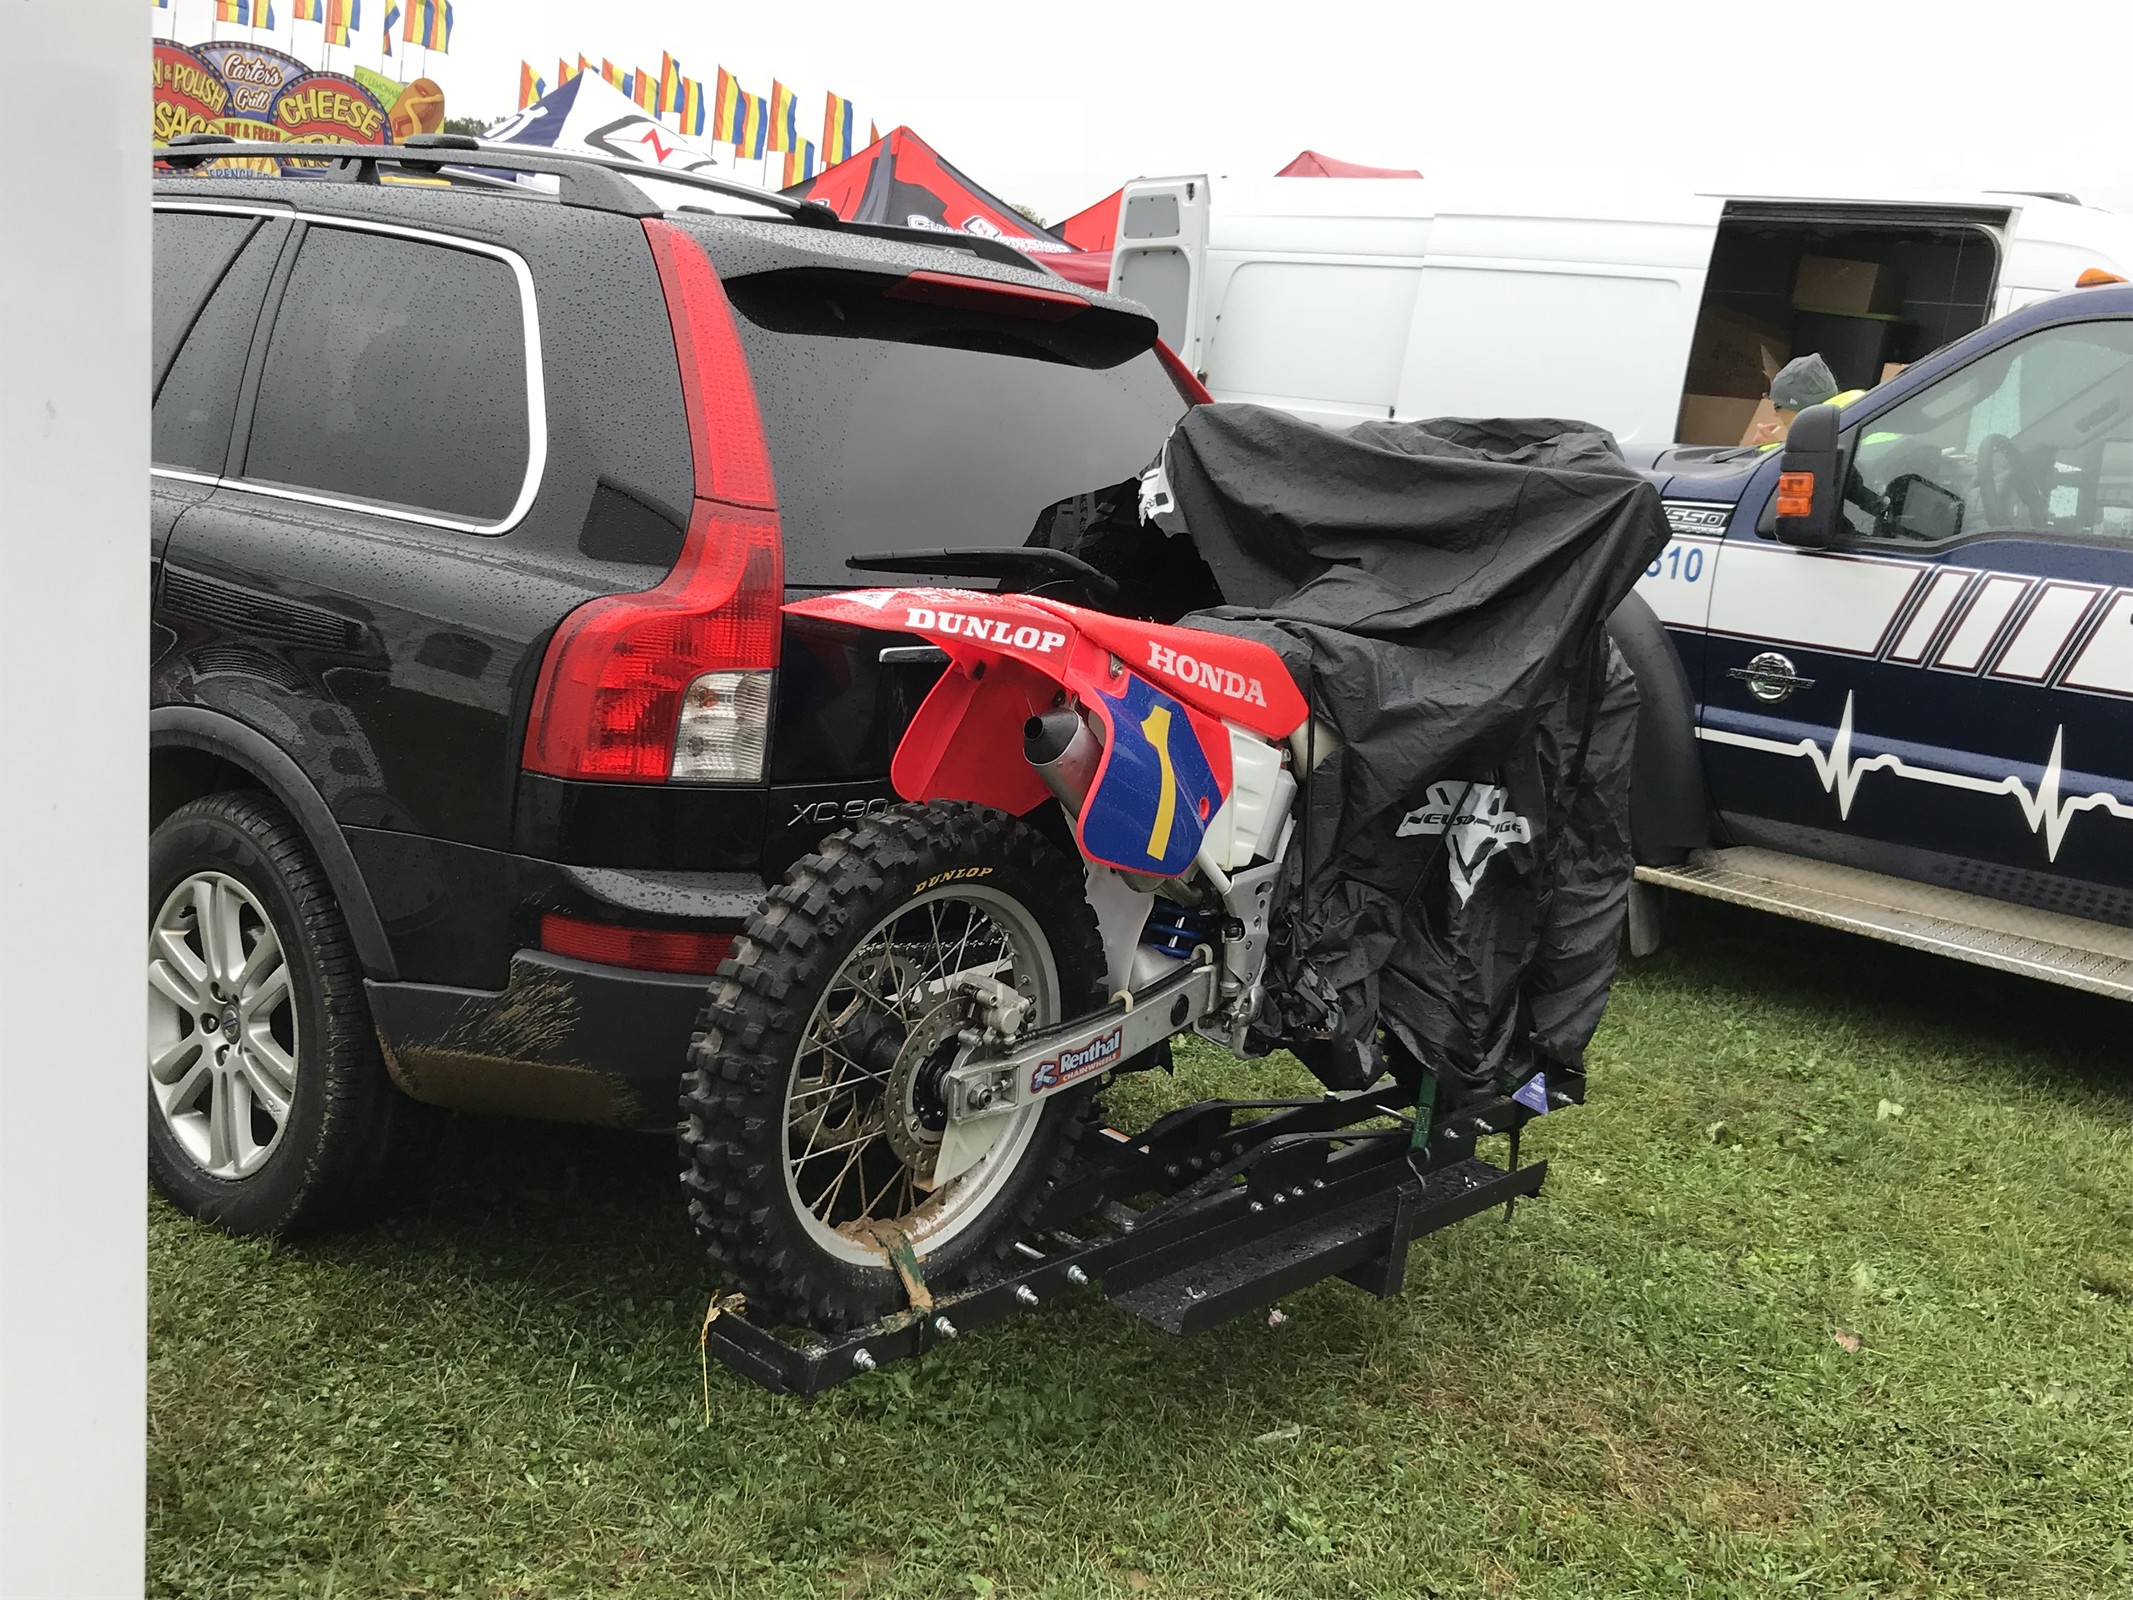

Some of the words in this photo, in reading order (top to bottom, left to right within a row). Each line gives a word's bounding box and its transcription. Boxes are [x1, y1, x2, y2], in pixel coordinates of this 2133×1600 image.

[165, 65, 172, 81] &
[173, 62, 227, 114] POLISH
[224, 54, 281, 86] Carter's
[236, 89, 269, 109] Grill
[279, 88, 384, 138] CHEESE
[1664, 507, 1727, 528] 550
[904, 607, 1066, 653] DUNLOP
[1147, 640, 1267, 708] HONDA
[1140, 704, 1171, 861] 1
[913, 866, 994, 896] DUNLOP
[1060, 1031, 1120, 1073] Renthal
[1062, 1053, 1117, 1082] CHAINWHEELS
